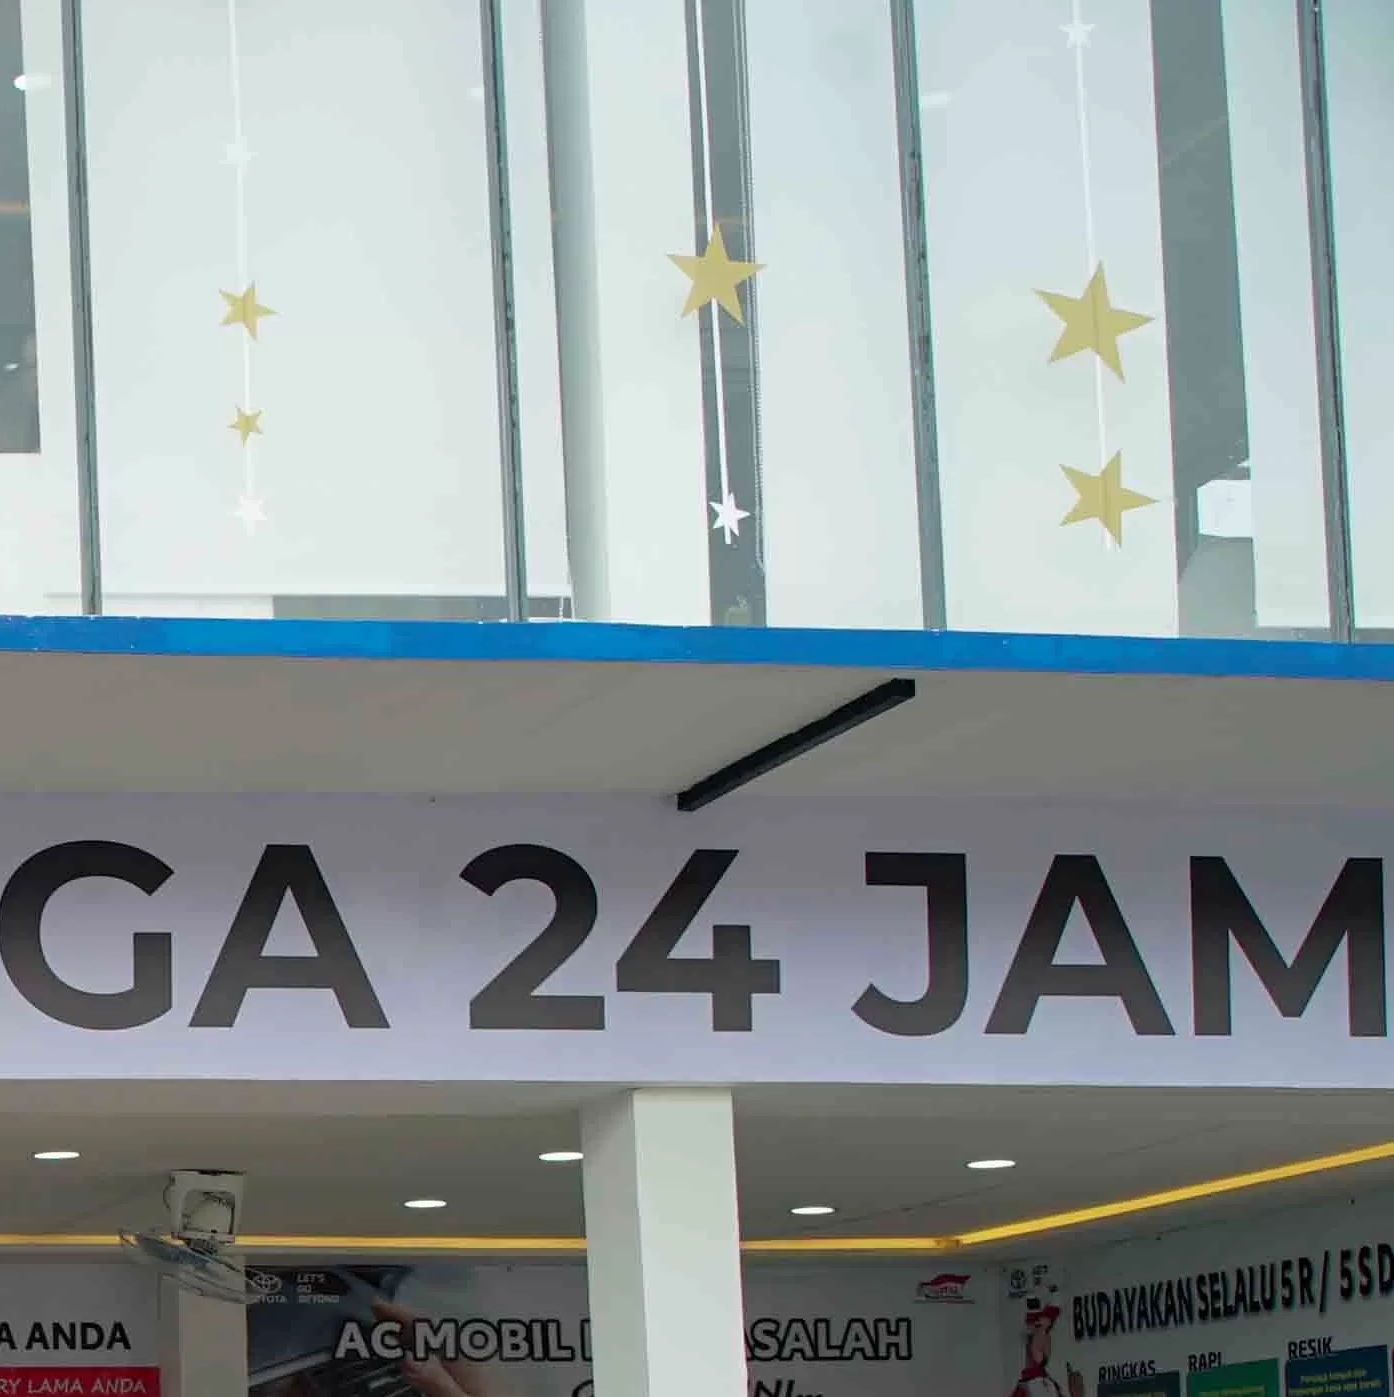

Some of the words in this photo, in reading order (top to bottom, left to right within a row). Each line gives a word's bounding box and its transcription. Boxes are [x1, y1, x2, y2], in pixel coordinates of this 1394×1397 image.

[459, 843, 781, 1032] 24
[850, 852, 1387, 1037] JAM
[1073, 1275, 1193, 1340] BUDAYAKAN
[1196, 1262, 1276, 1321] SELALU
[26, 1321, 131, 1350] ANDA
[333, 1319, 406, 1361] AC
[412, 1318, 576, 1362] MOBIL
[1287, 1336, 1333, 1360] RESIK
[1098, 1359, 1156, 1382] RINGKAS
[1187, 1351, 1222, 1372] RAPI
[27, 1377, 84, 1394] LAMA
[90, 1376, 147, 1395] ANDA
